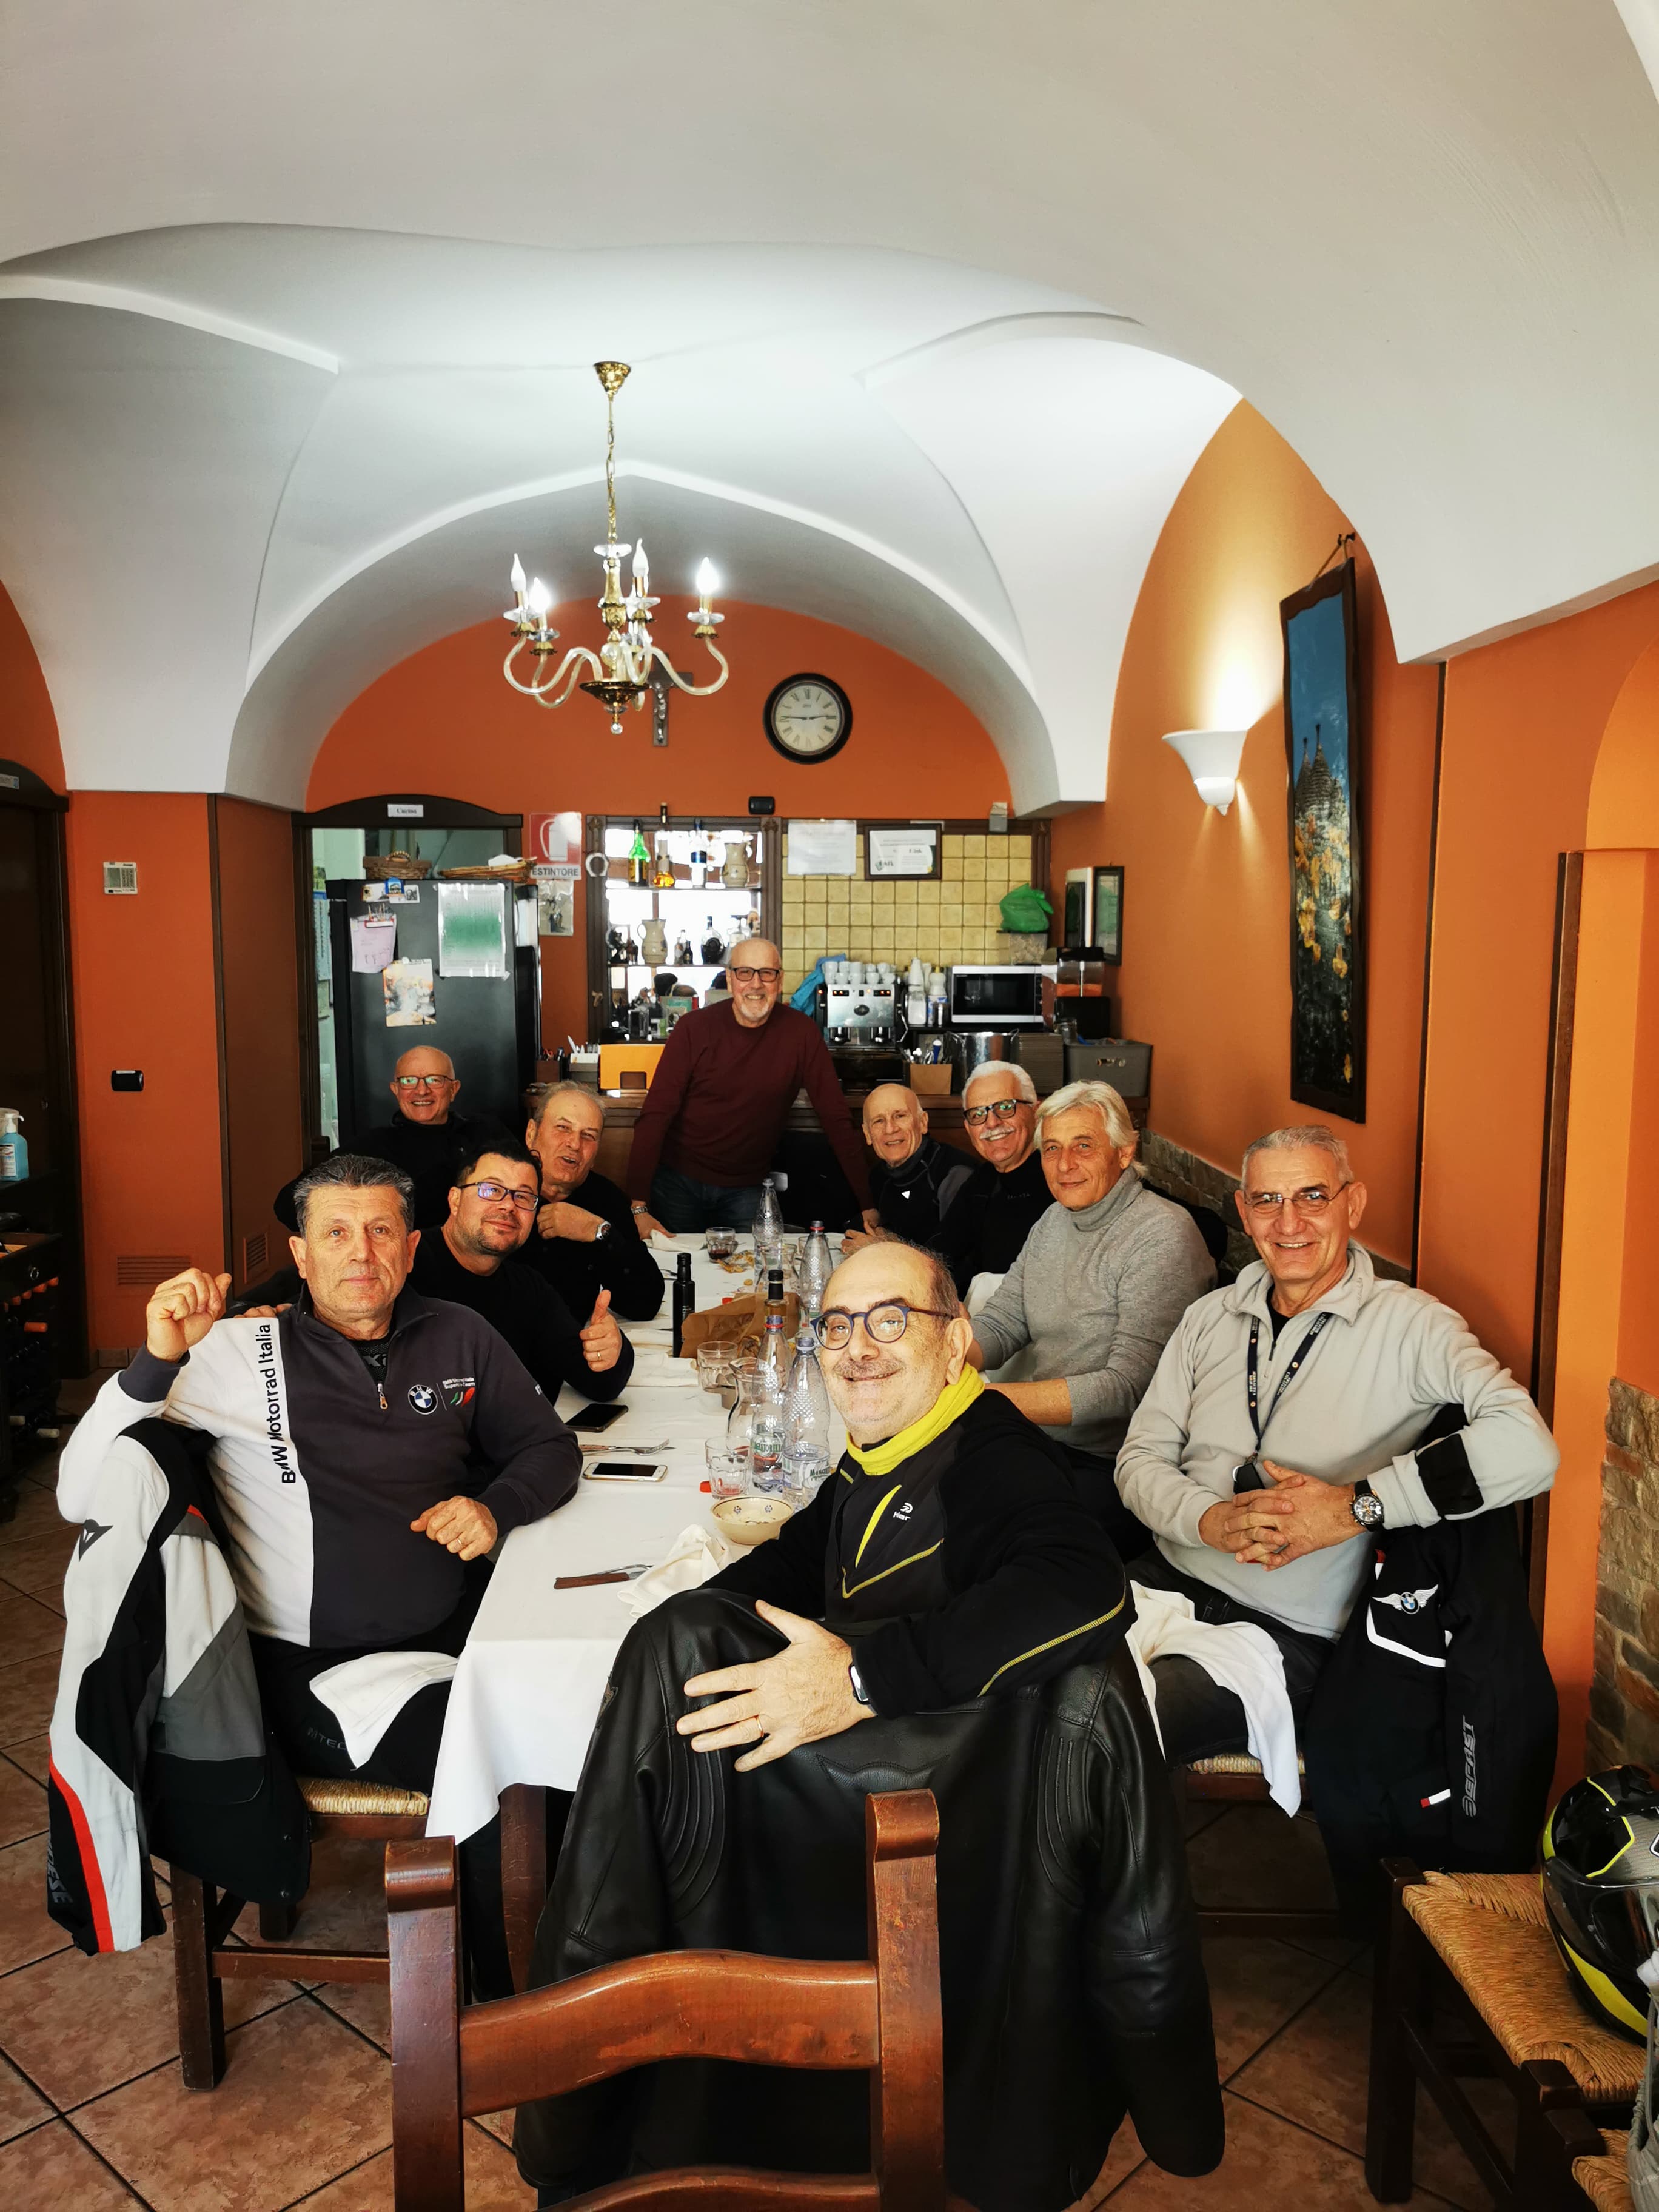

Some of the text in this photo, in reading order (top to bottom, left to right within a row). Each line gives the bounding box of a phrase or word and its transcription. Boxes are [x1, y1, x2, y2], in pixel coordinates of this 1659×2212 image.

[532, 868, 578, 876] ESTINTORE
[255, 1324, 274, 1364] Italia
[260, 1367, 286, 1441] Motorrad
